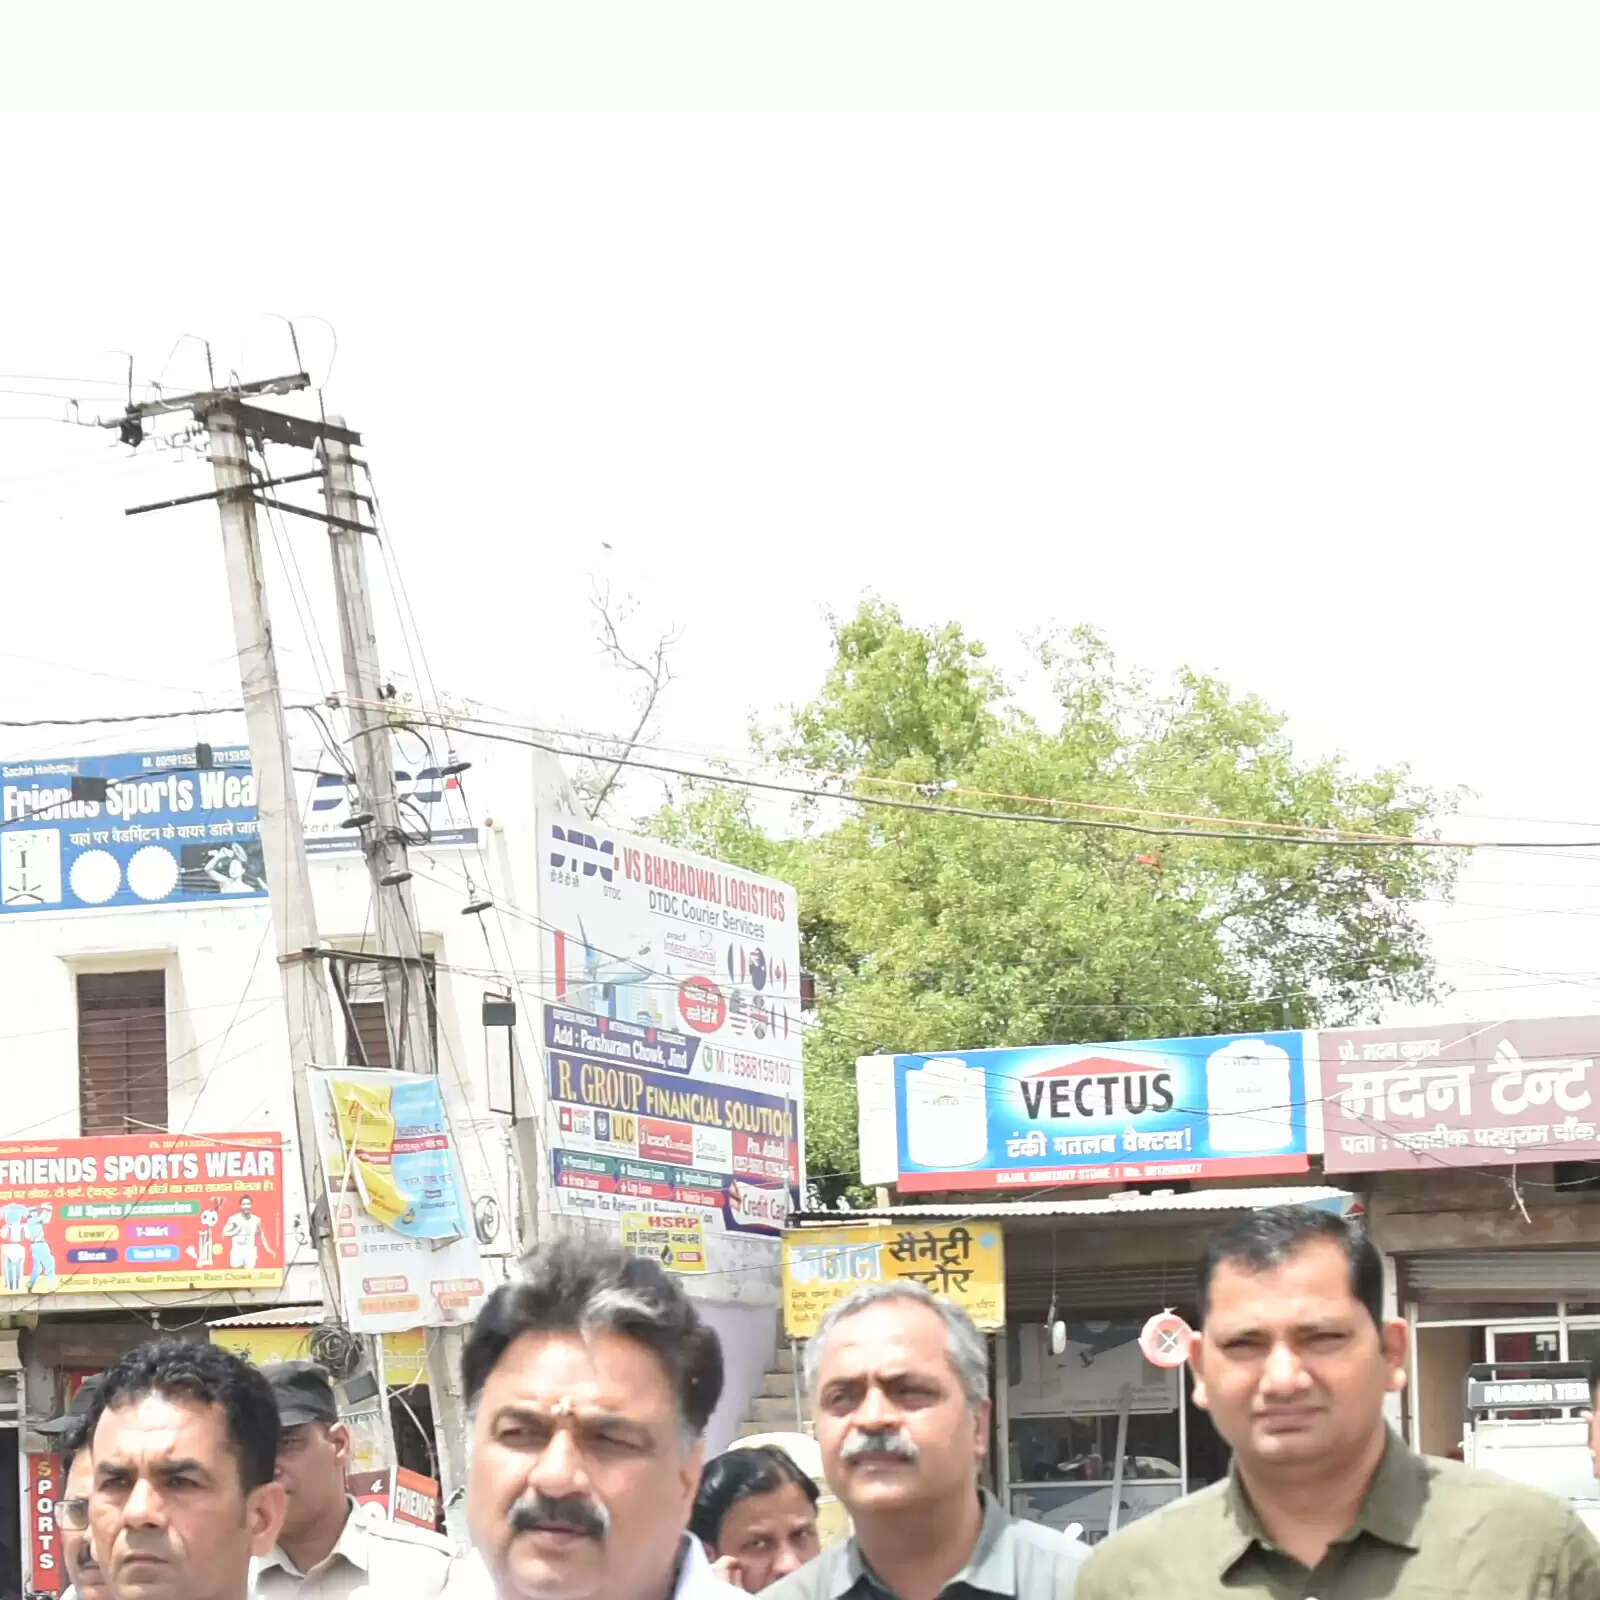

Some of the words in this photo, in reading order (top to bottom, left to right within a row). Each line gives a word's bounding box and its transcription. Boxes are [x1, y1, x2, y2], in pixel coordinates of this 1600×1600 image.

[106, 775, 194, 820] Sports
[199, 772, 258, 809] Wea
[623, 846, 642, 884] VS
[644, 852, 722, 906] BHARADWAJ
[724, 876, 786, 923] LOGISTICS
[648, 889, 679, 916] DTDC
[681, 899, 720, 927] Courier
[721, 909, 765, 939] Services
[554, 1024, 573, 1045] Add
[581, 1029, 631, 1057] Parshuram
[667, 1048, 688, 1069] Jind
[558, 1059, 577, 1101] R.
[580, 1064, 643, 1112] GROUP
[645, 1087, 722, 1127] FINANCIAL
[1020, 1072, 1175, 1121] VECTUS
[1337, 1064, 1475, 1122] मदन
[1487, 1038, 1592, 1116] टैन्ट
[612, 1117, 635, 1143] LIC
[1006, 1130, 1049, 1159] टंकी
[103, 1153, 199, 1182] SPORTS
[204, 1150, 276, 1179] WEAR
[66, 1205, 83, 1216] All
[85, 1204, 122, 1218] Sports
[124, 1202, 193, 1215] Accessories
[647, 1215, 699, 1228] HSRP
[742, 1192, 769, 1219] Credit
[77, 1230, 105, 1239] Lower
[136, 1226, 169, 1237] T-Shirt
[885, 1226, 975, 1267] सैनेट्री
[135, 1273, 153, 1284] Near
[37, 1461, 55, 1569] SPORTS
